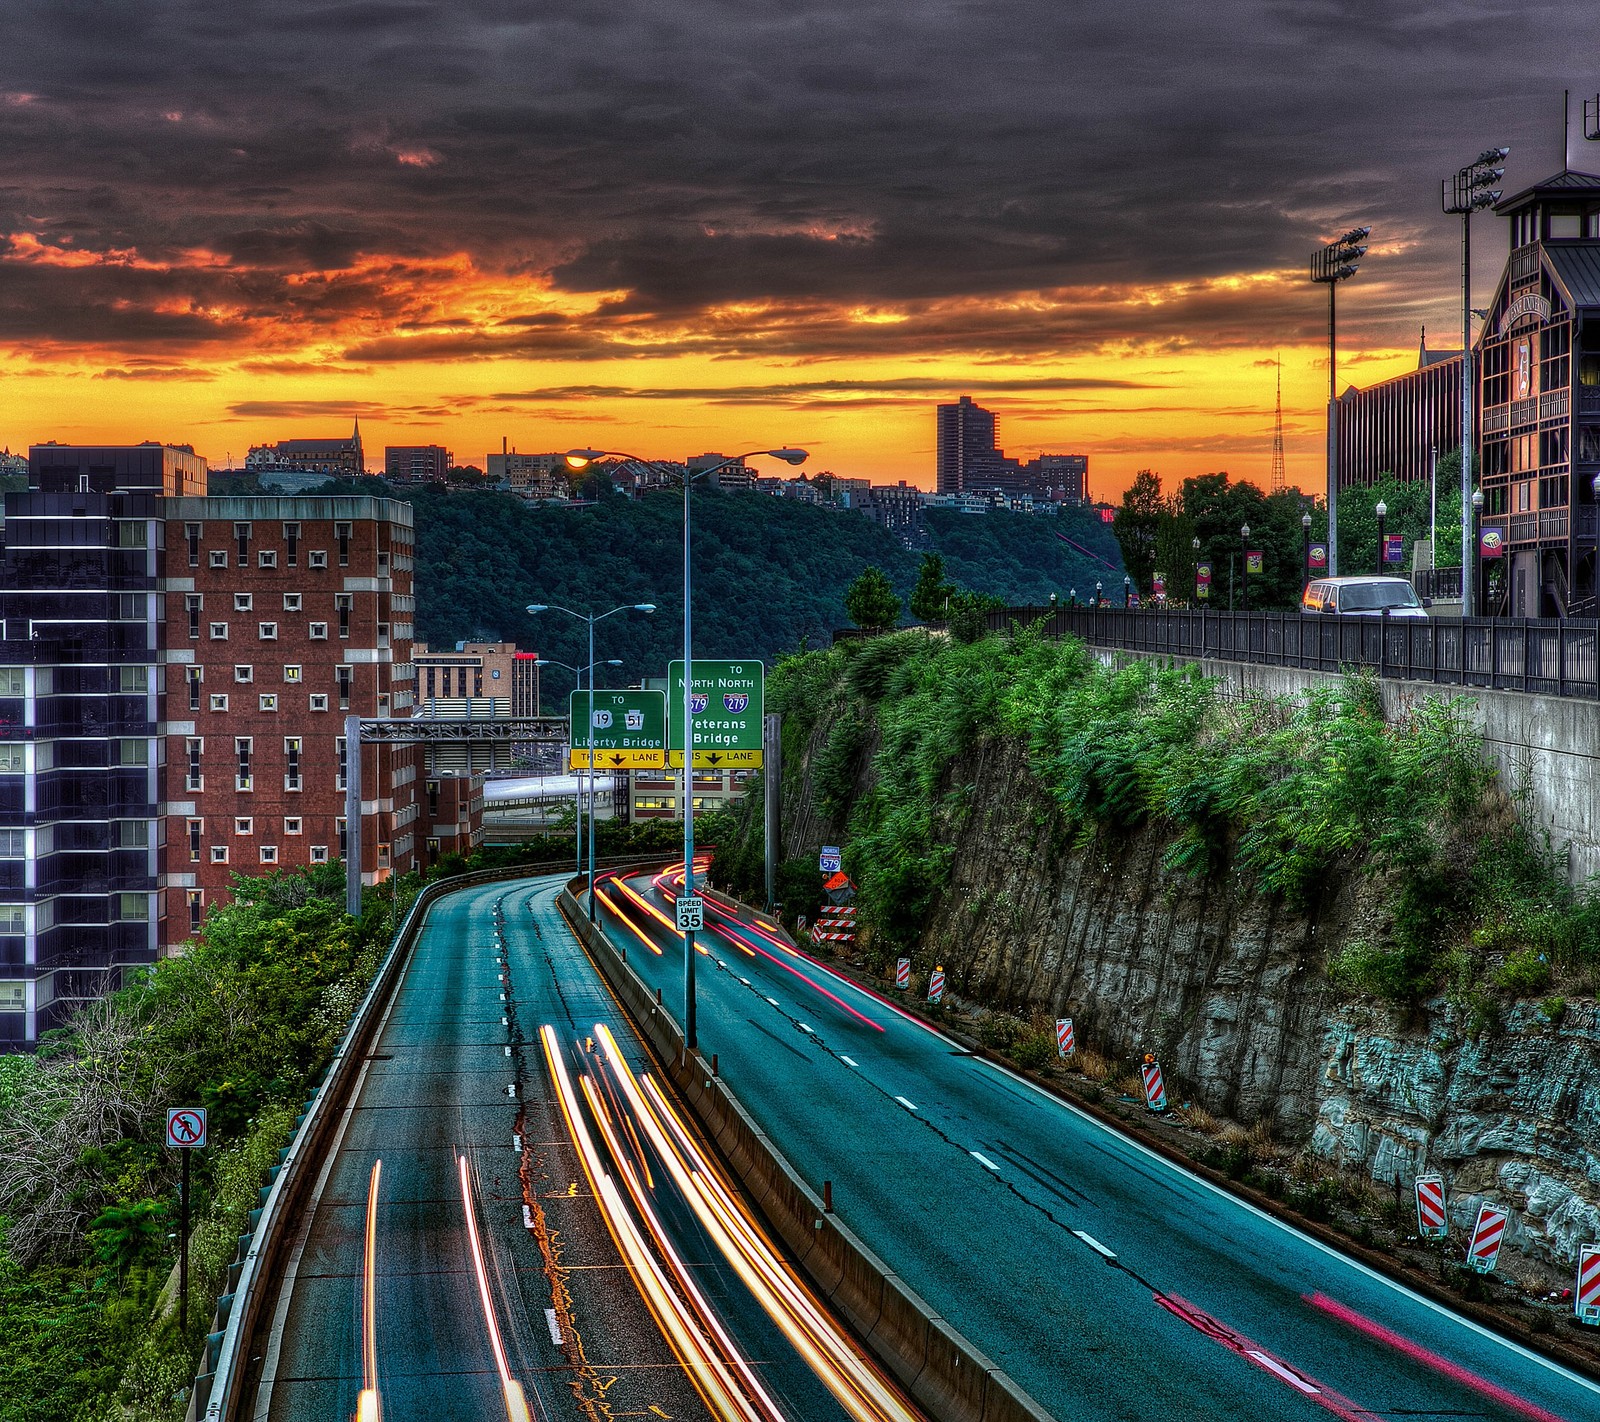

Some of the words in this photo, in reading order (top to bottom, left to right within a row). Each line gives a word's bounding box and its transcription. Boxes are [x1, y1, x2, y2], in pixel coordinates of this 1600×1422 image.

[729, 665, 743, 674] TO
[718, 678, 754, 688] NORTH
[611, 696, 625, 704] TO
[728, 698, 745, 709] 279
[596, 713, 609, 725] 19
[627, 715, 641, 727] 51
[623, 737, 661, 749] Bridge
[693, 733, 739, 746] Bridge
[632, 753, 659, 761] LANE
[679, 752, 701, 760] TIS
[727, 752, 753, 760] LANE
[823, 859, 840, 868] 579
[679, 914, 701, 928] 35
